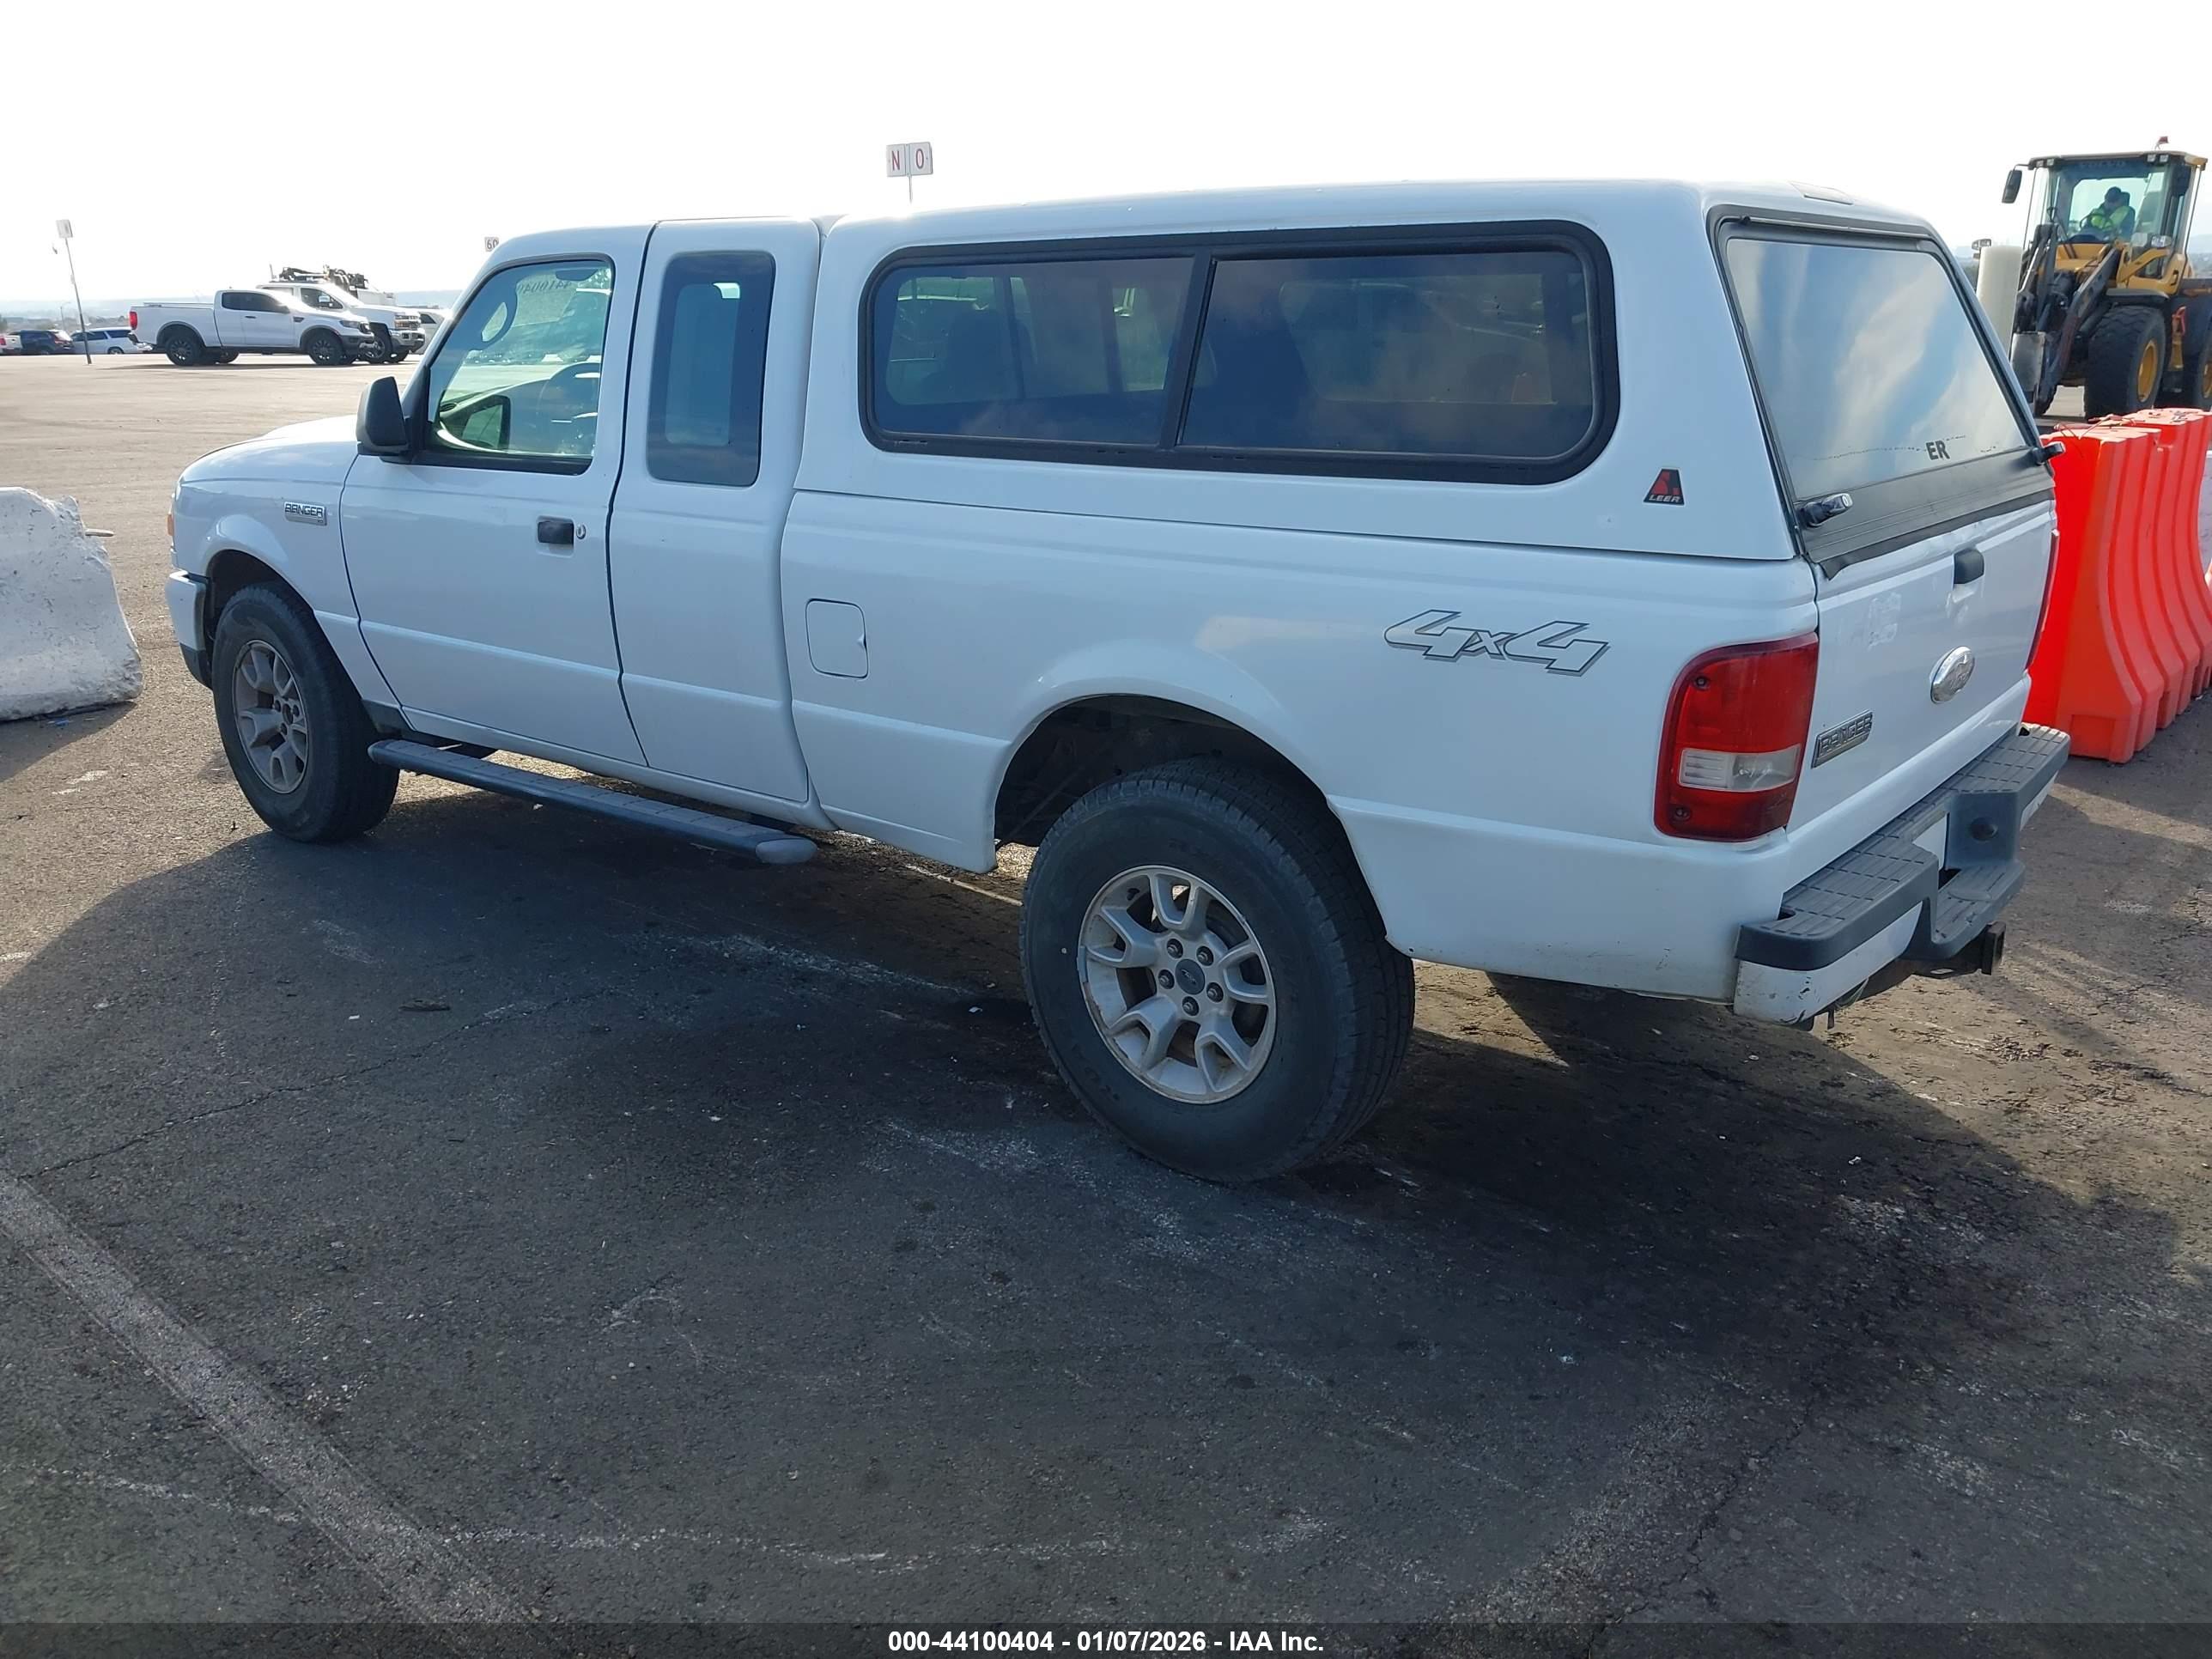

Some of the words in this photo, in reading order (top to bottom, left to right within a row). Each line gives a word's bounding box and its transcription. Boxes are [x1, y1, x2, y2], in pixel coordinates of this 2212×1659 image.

[1925, 439, 1951, 460] ER
[1648, 494, 1682, 503] LEER
[284, 502, 325, 519] RANGER
[1384, 609, 1612, 677] 4x4
[1819, 713, 1873, 757] RANGER
